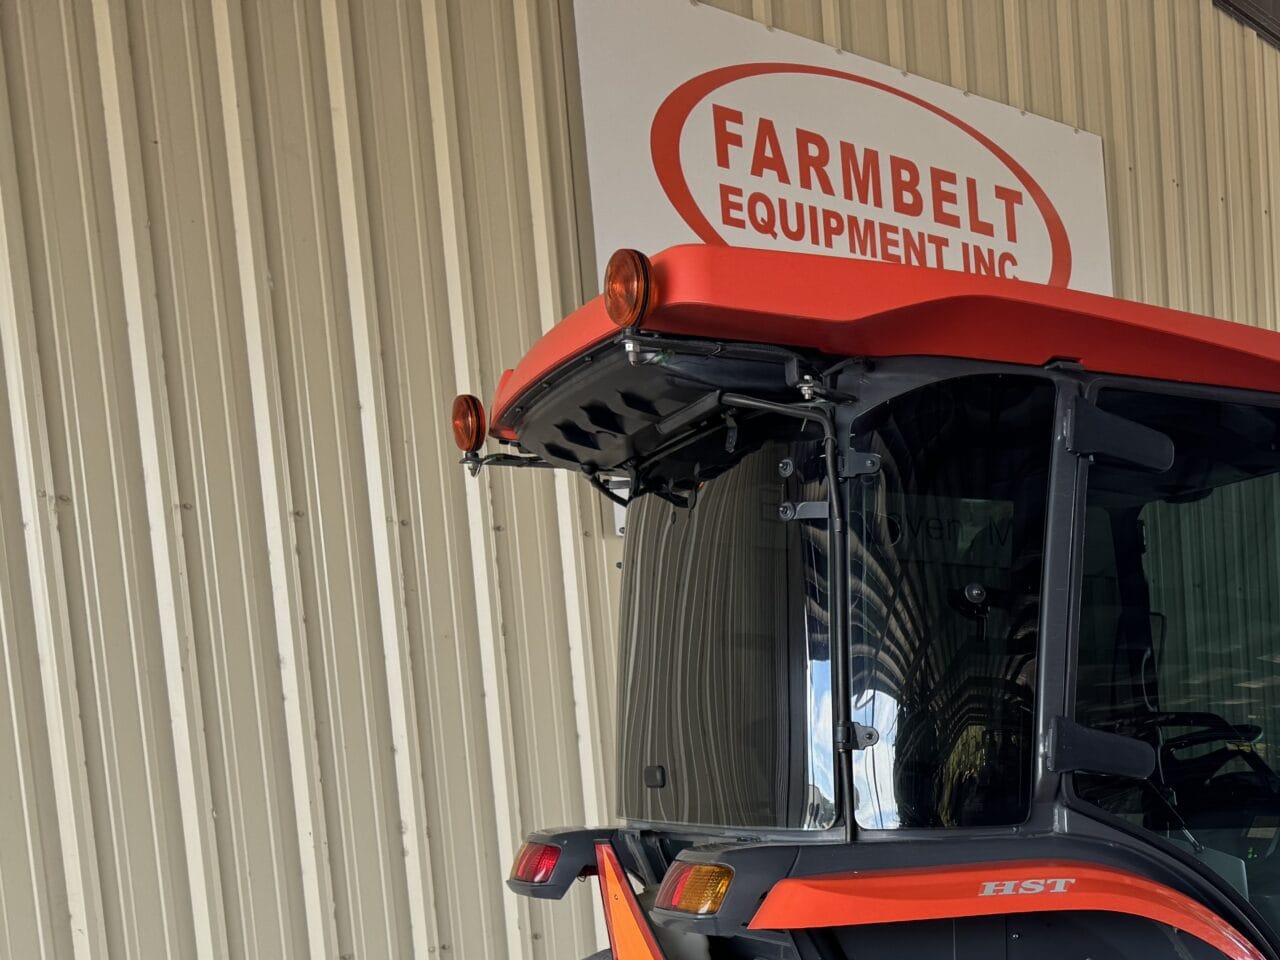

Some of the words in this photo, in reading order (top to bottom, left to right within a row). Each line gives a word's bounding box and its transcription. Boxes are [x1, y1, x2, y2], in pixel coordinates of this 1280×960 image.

[712, 103, 1023, 244] FARMBELT
[719, 183, 950, 270] EQUIPMENT
[962, 242, 1018, 281] INC
[978, 879, 1076, 897] HST
